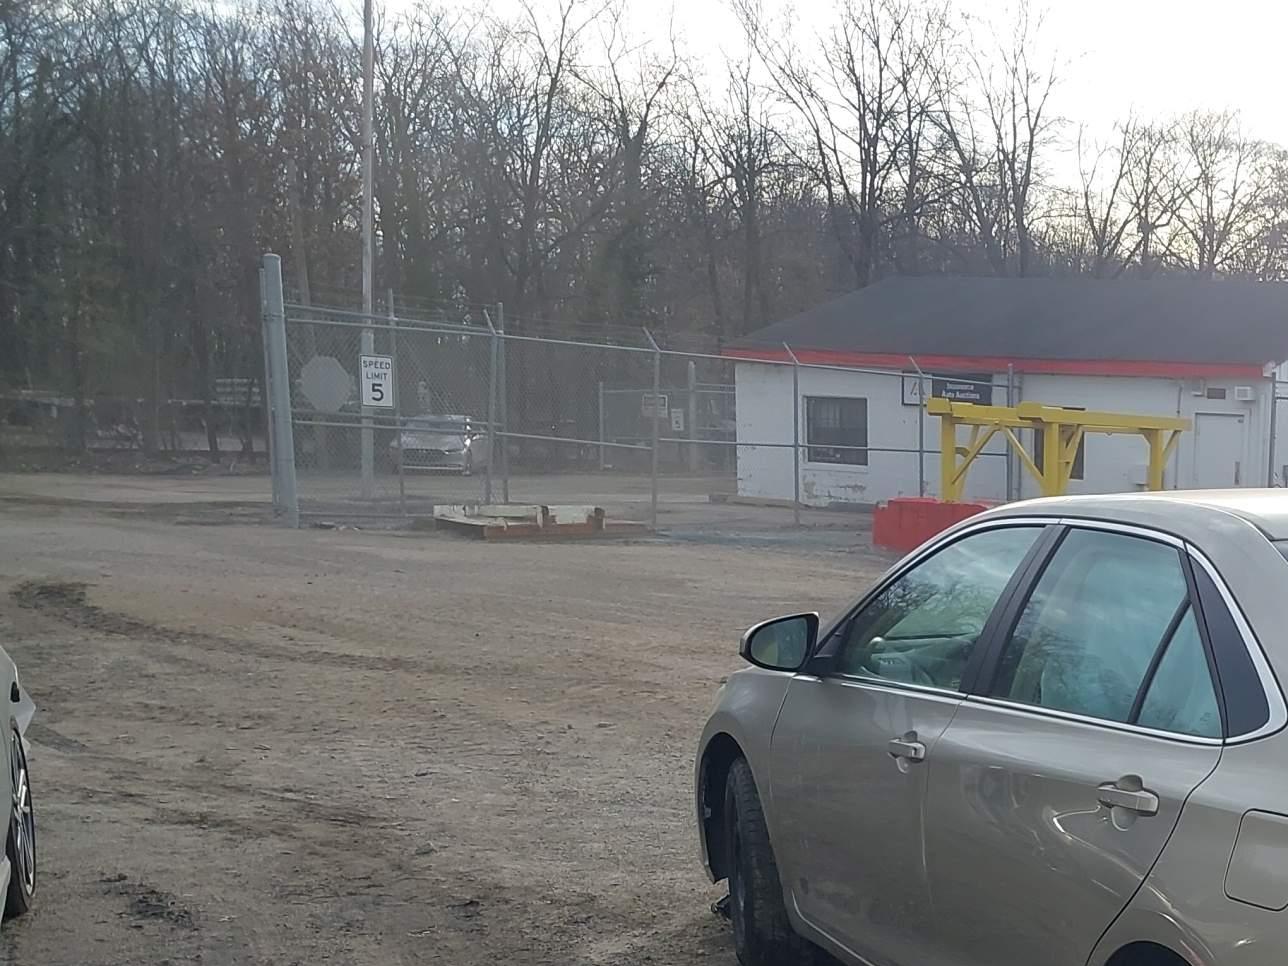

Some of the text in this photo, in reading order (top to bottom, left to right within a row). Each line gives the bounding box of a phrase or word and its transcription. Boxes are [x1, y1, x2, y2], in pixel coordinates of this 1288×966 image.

[363, 360, 391, 370] SPEED
[366, 371, 388, 381] LIMIT
[372, 383, 384, 401] 5
